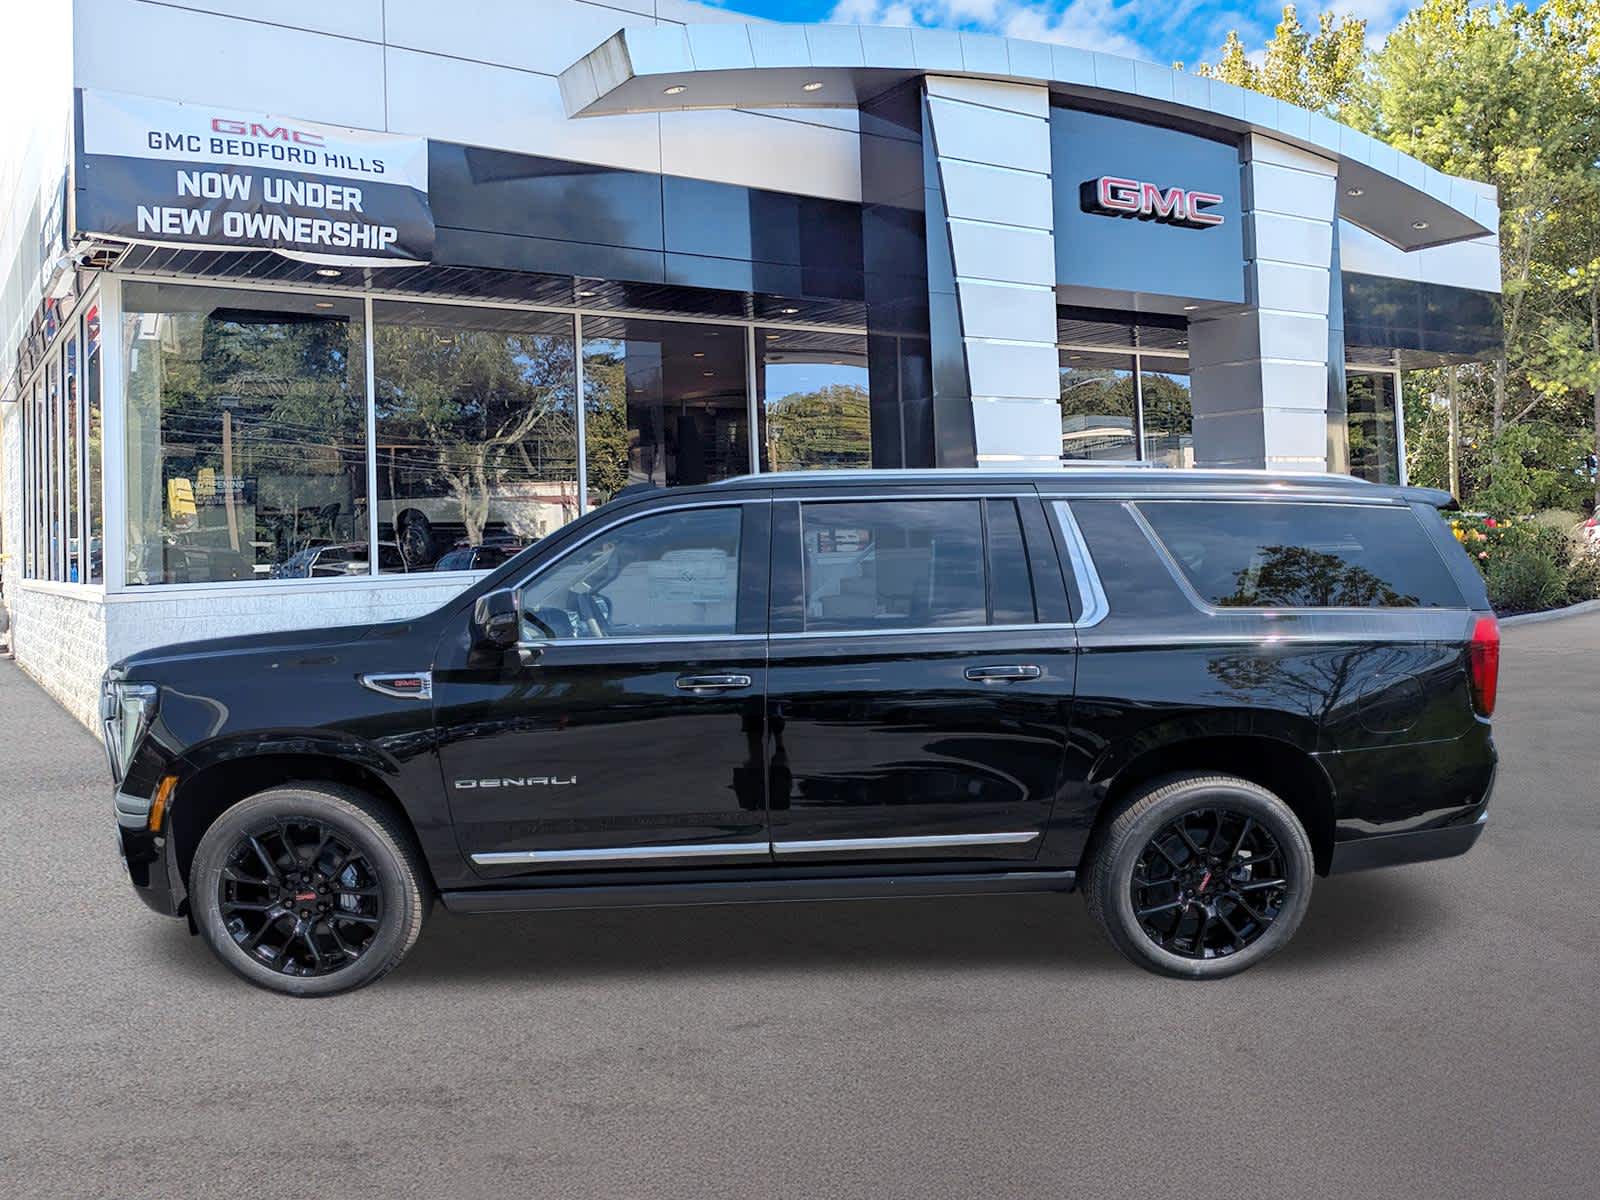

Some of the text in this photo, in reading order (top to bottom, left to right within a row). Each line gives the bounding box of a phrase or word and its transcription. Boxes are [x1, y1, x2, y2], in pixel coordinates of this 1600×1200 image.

[148, 131, 385, 174] GMC BEDFORD HILLS
[211, 118, 325, 148] GMC
[177, 170, 364, 212] NOW UNDER
[1098, 176, 1225, 225] GMC
[137, 206, 398, 250] NEW OWNERSHIP
[454, 775, 577, 789] DENALI
